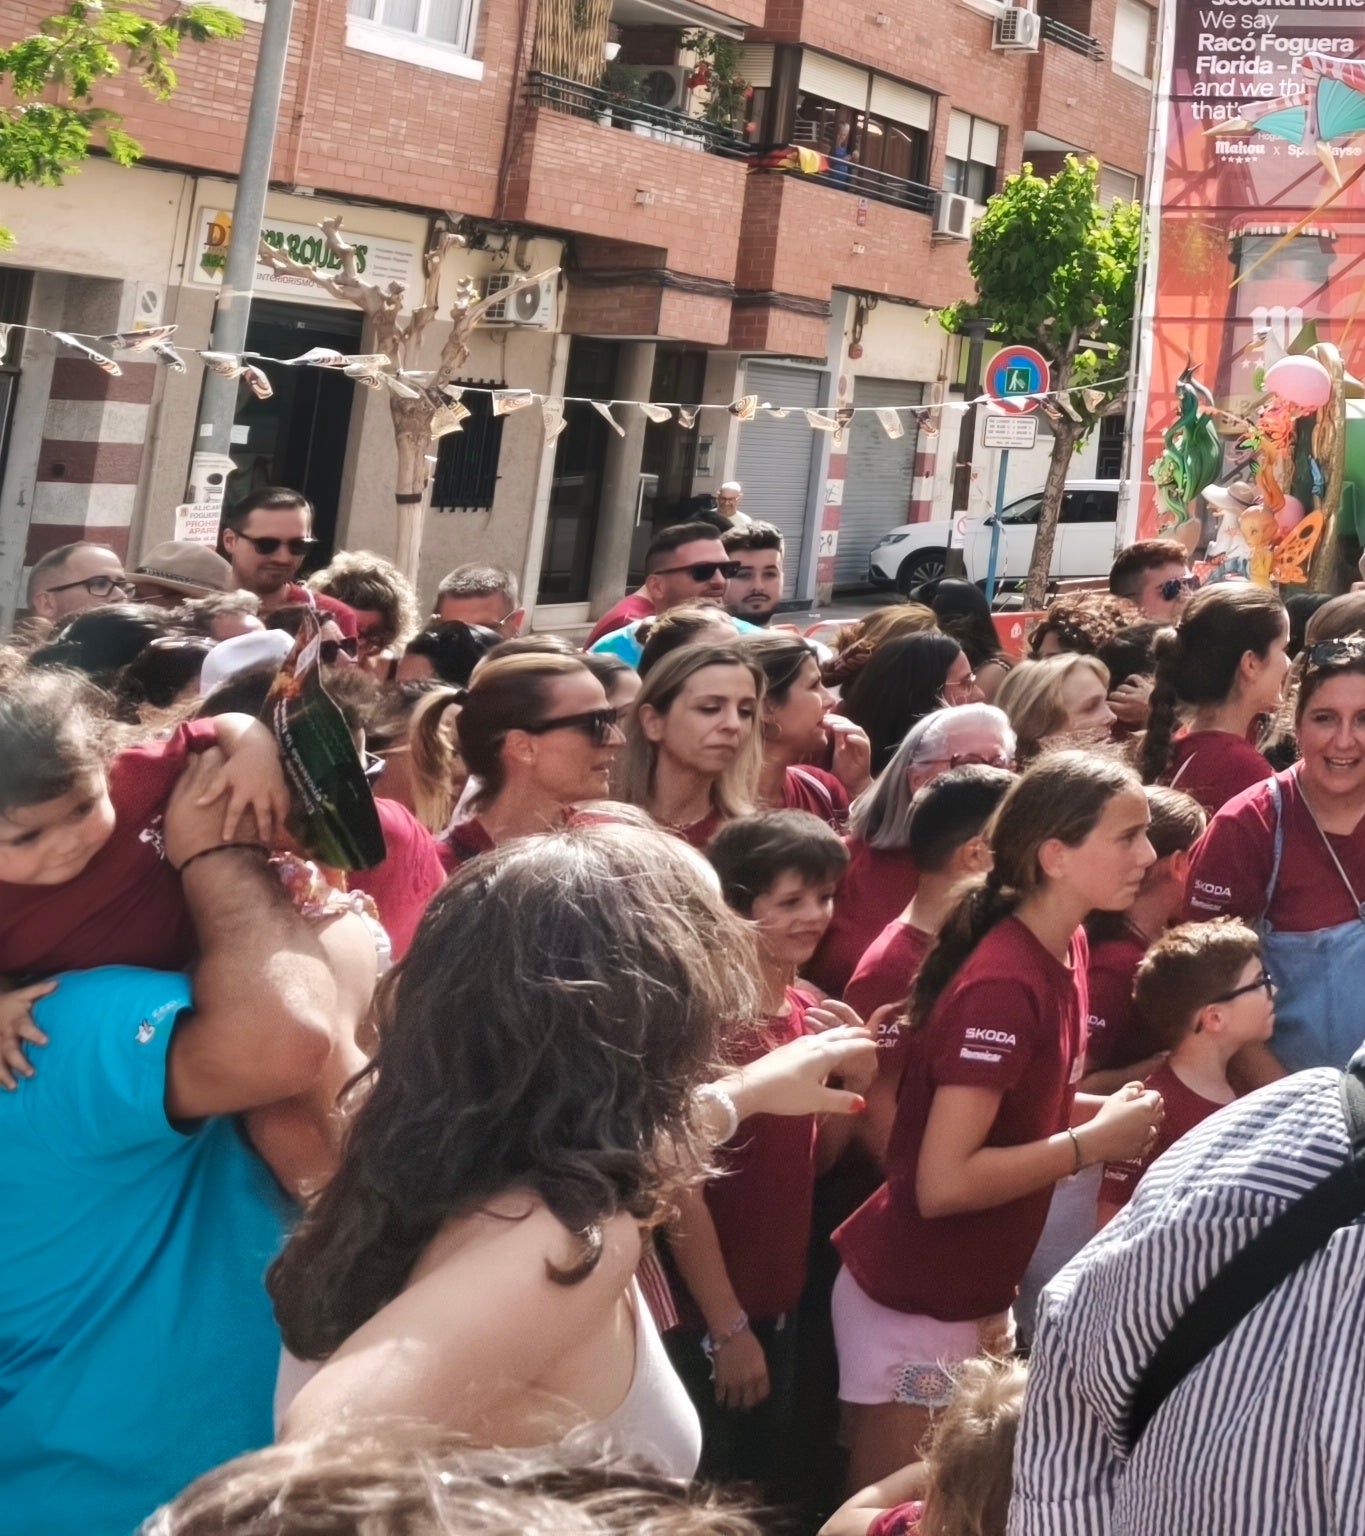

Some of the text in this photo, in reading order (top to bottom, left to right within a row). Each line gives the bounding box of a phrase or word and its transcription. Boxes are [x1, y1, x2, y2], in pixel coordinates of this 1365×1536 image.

[1199, 10, 1279, 33] We say
[1197, 31, 1354, 56] Racó Foguera
[1196, 56, 1273, 75] Florida
[1192, 78, 1306, 97] and we thi
[1214, 141, 1266, 155] Mahou
[964, 1027, 1017, 1046] SKODA
